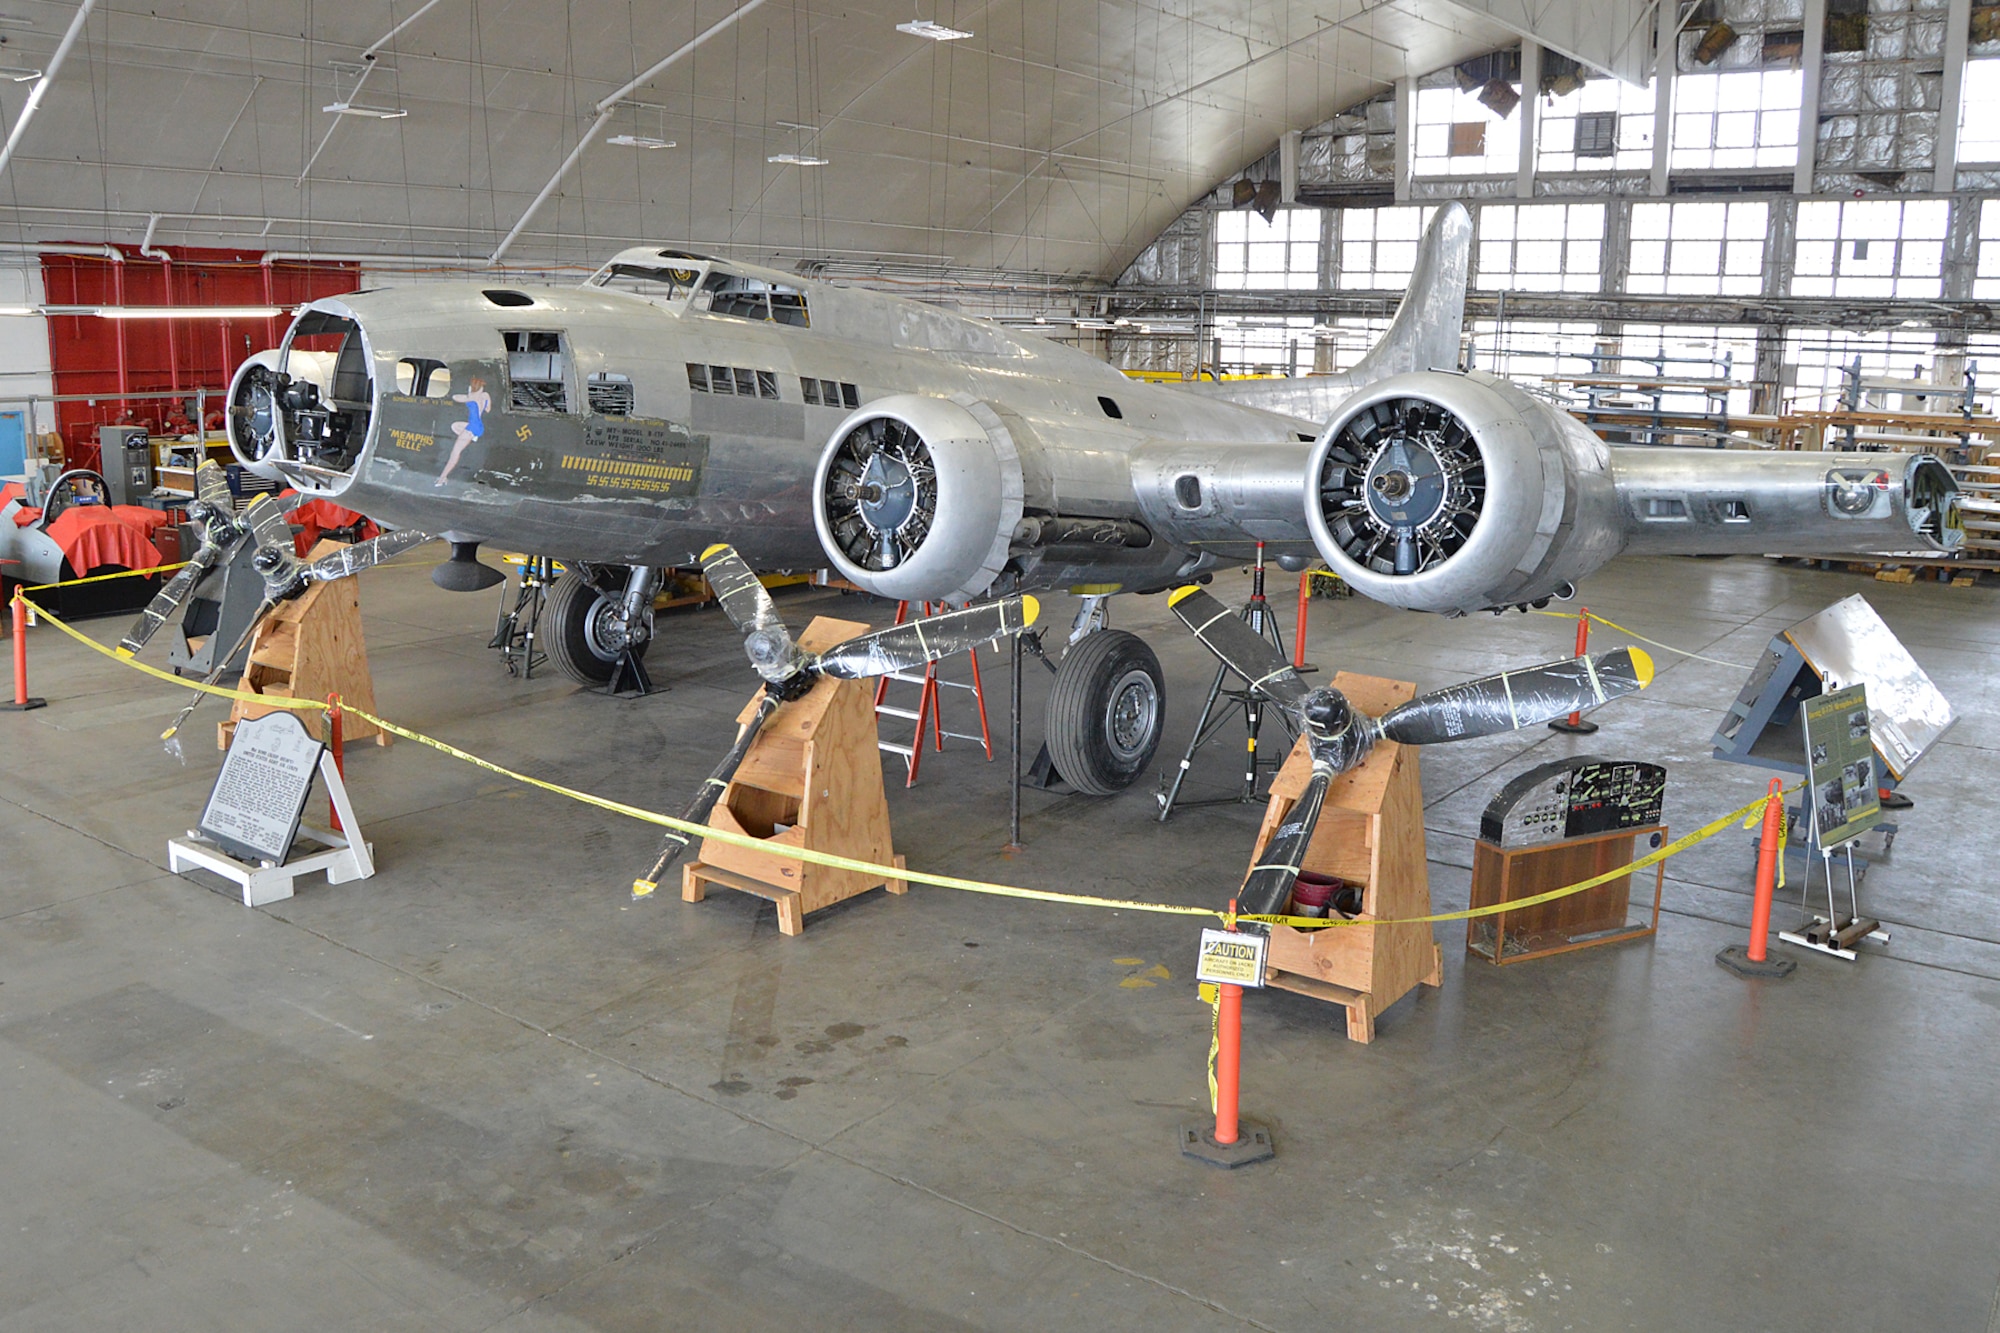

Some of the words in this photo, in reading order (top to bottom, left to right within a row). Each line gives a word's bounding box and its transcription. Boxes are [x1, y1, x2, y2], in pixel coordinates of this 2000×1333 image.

[622, 428, 643, 436] MODEL
[623, 436, 643, 444] SERIAL
[608, 441, 633, 450] WEIGHT
[1207, 942, 1254, 960] CAUTION
